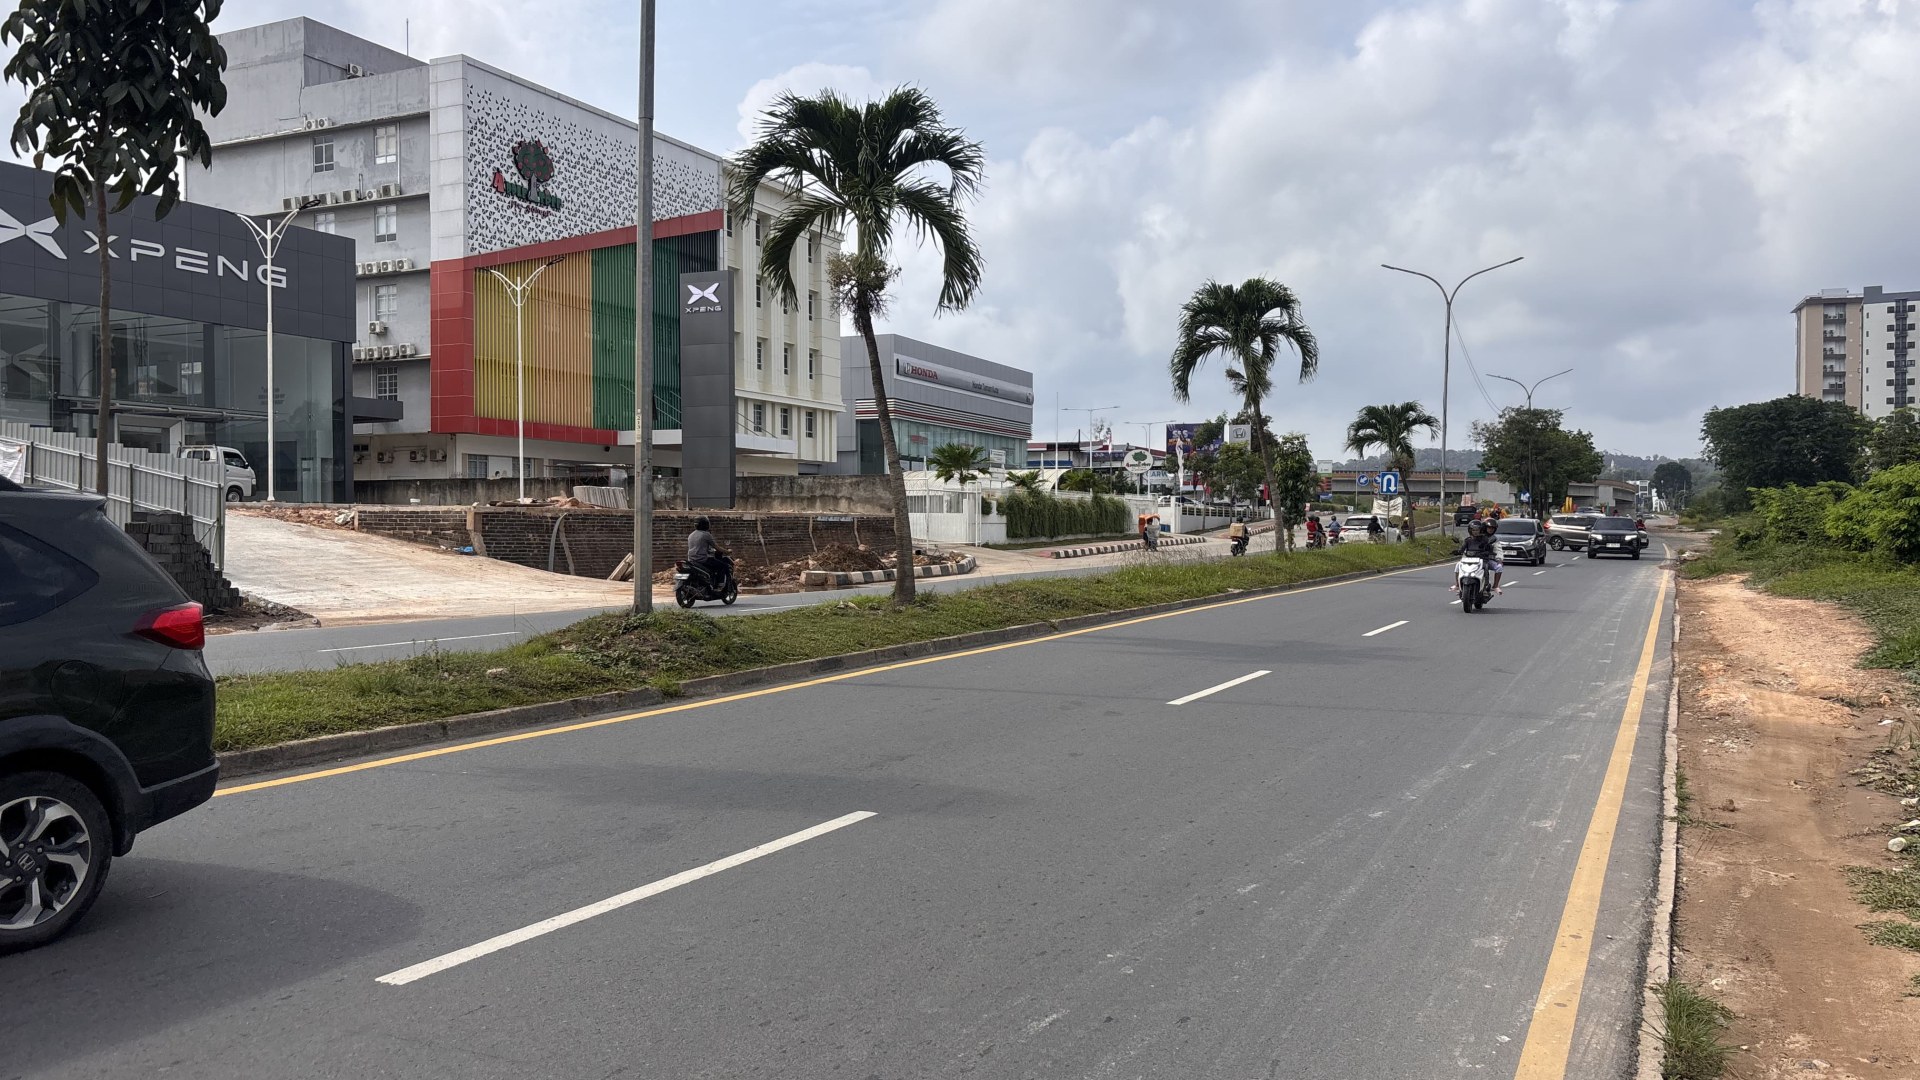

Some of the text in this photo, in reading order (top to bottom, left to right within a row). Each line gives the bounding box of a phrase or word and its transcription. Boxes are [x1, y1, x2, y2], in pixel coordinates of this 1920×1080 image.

[83, 230, 287, 289] XPENG
[685, 305, 722, 314] XPENG
[911, 366, 938, 379] HONDA
